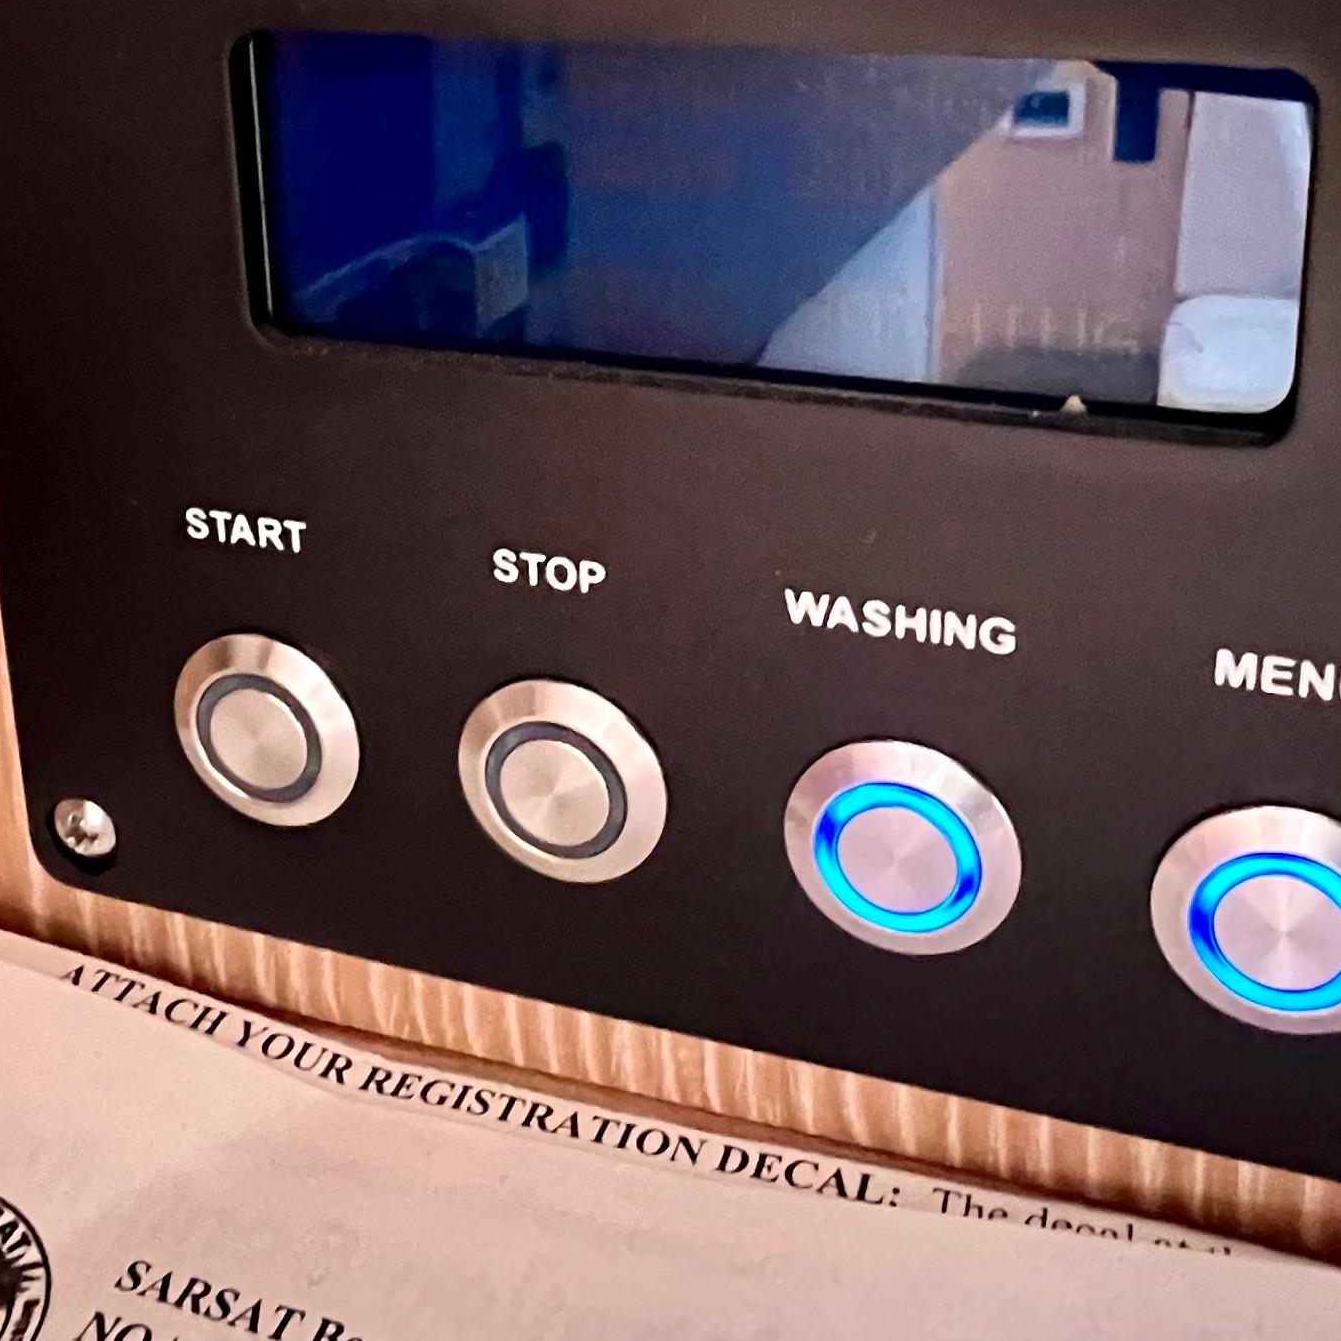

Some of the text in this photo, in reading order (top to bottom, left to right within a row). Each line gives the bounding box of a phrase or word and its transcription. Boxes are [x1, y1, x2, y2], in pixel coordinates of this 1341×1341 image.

[185, 507, 306, 553] START
[492, 548, 606, 594] STOP
[784, 588, 1016, 655] WASHING
[61, 964, 227, 1037] ATTACH
[237, 1019, 353, 1086] YOUR
[359, 1066, 708, 1166] REGISTRATION
[715, 1144, 901, 1208] DECAL:
[114, 1259, 306, 1341] SARSAT
